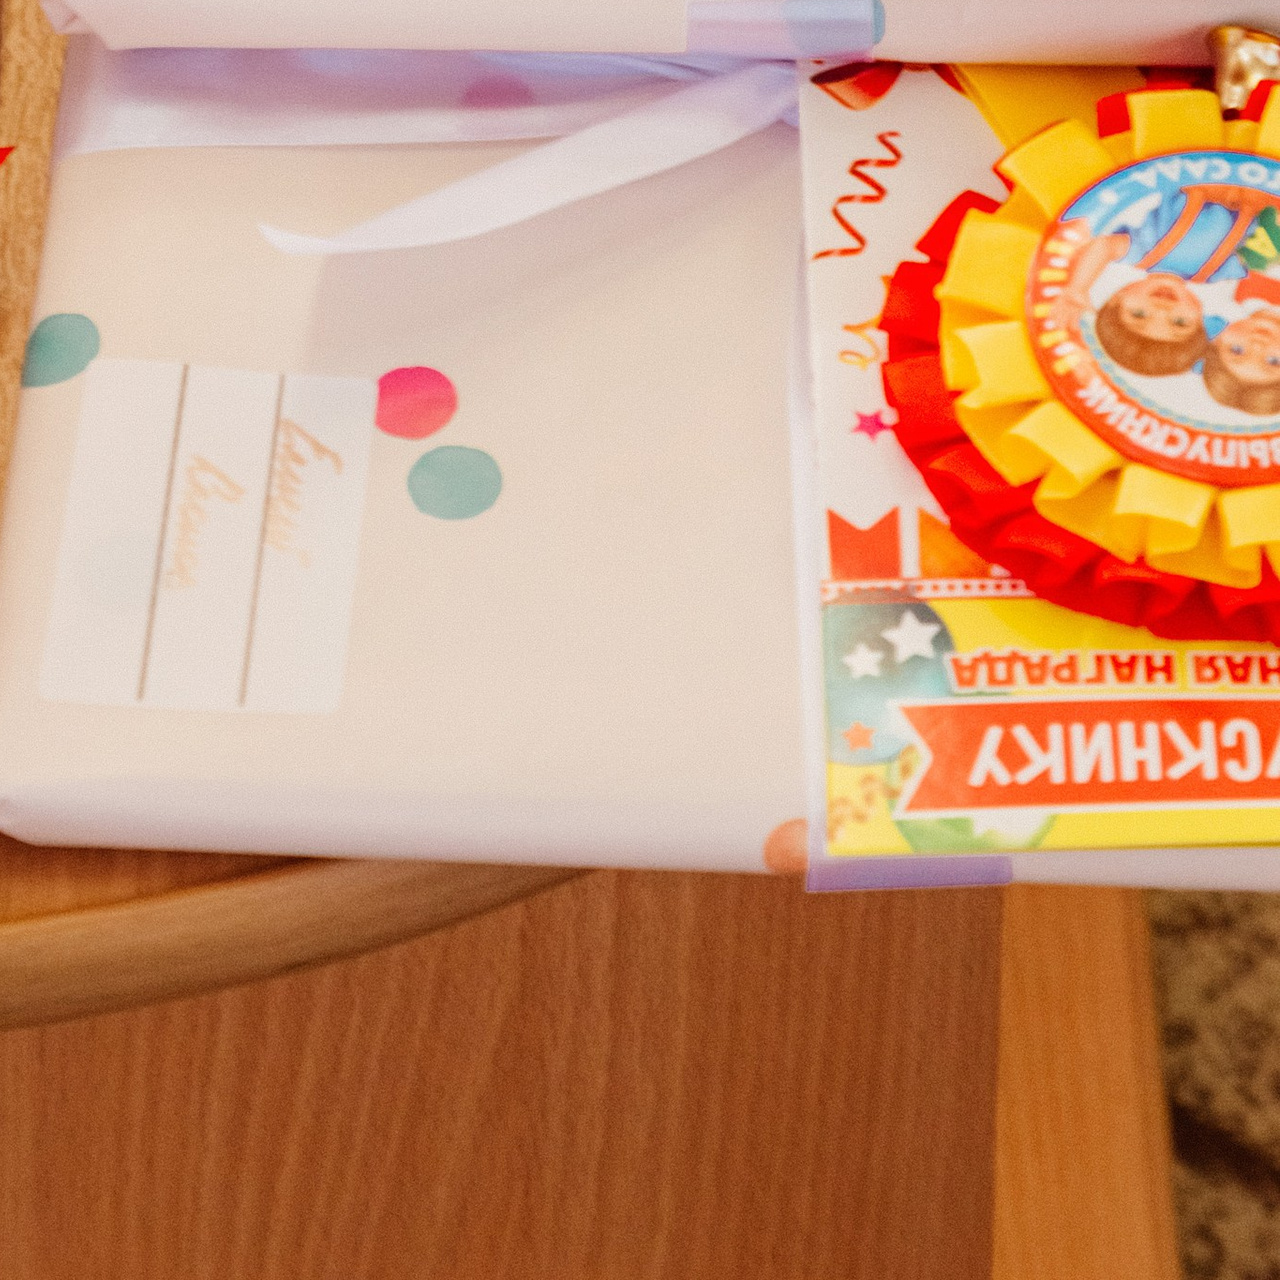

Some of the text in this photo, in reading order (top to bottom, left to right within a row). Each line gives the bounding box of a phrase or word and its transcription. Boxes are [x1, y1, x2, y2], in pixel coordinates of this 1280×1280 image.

[1131, 158, 1232, 189] САДА
[950, 651, 1172, 687] НАГРАДА
[968, 718, 1280, 787] СКНИКУ
